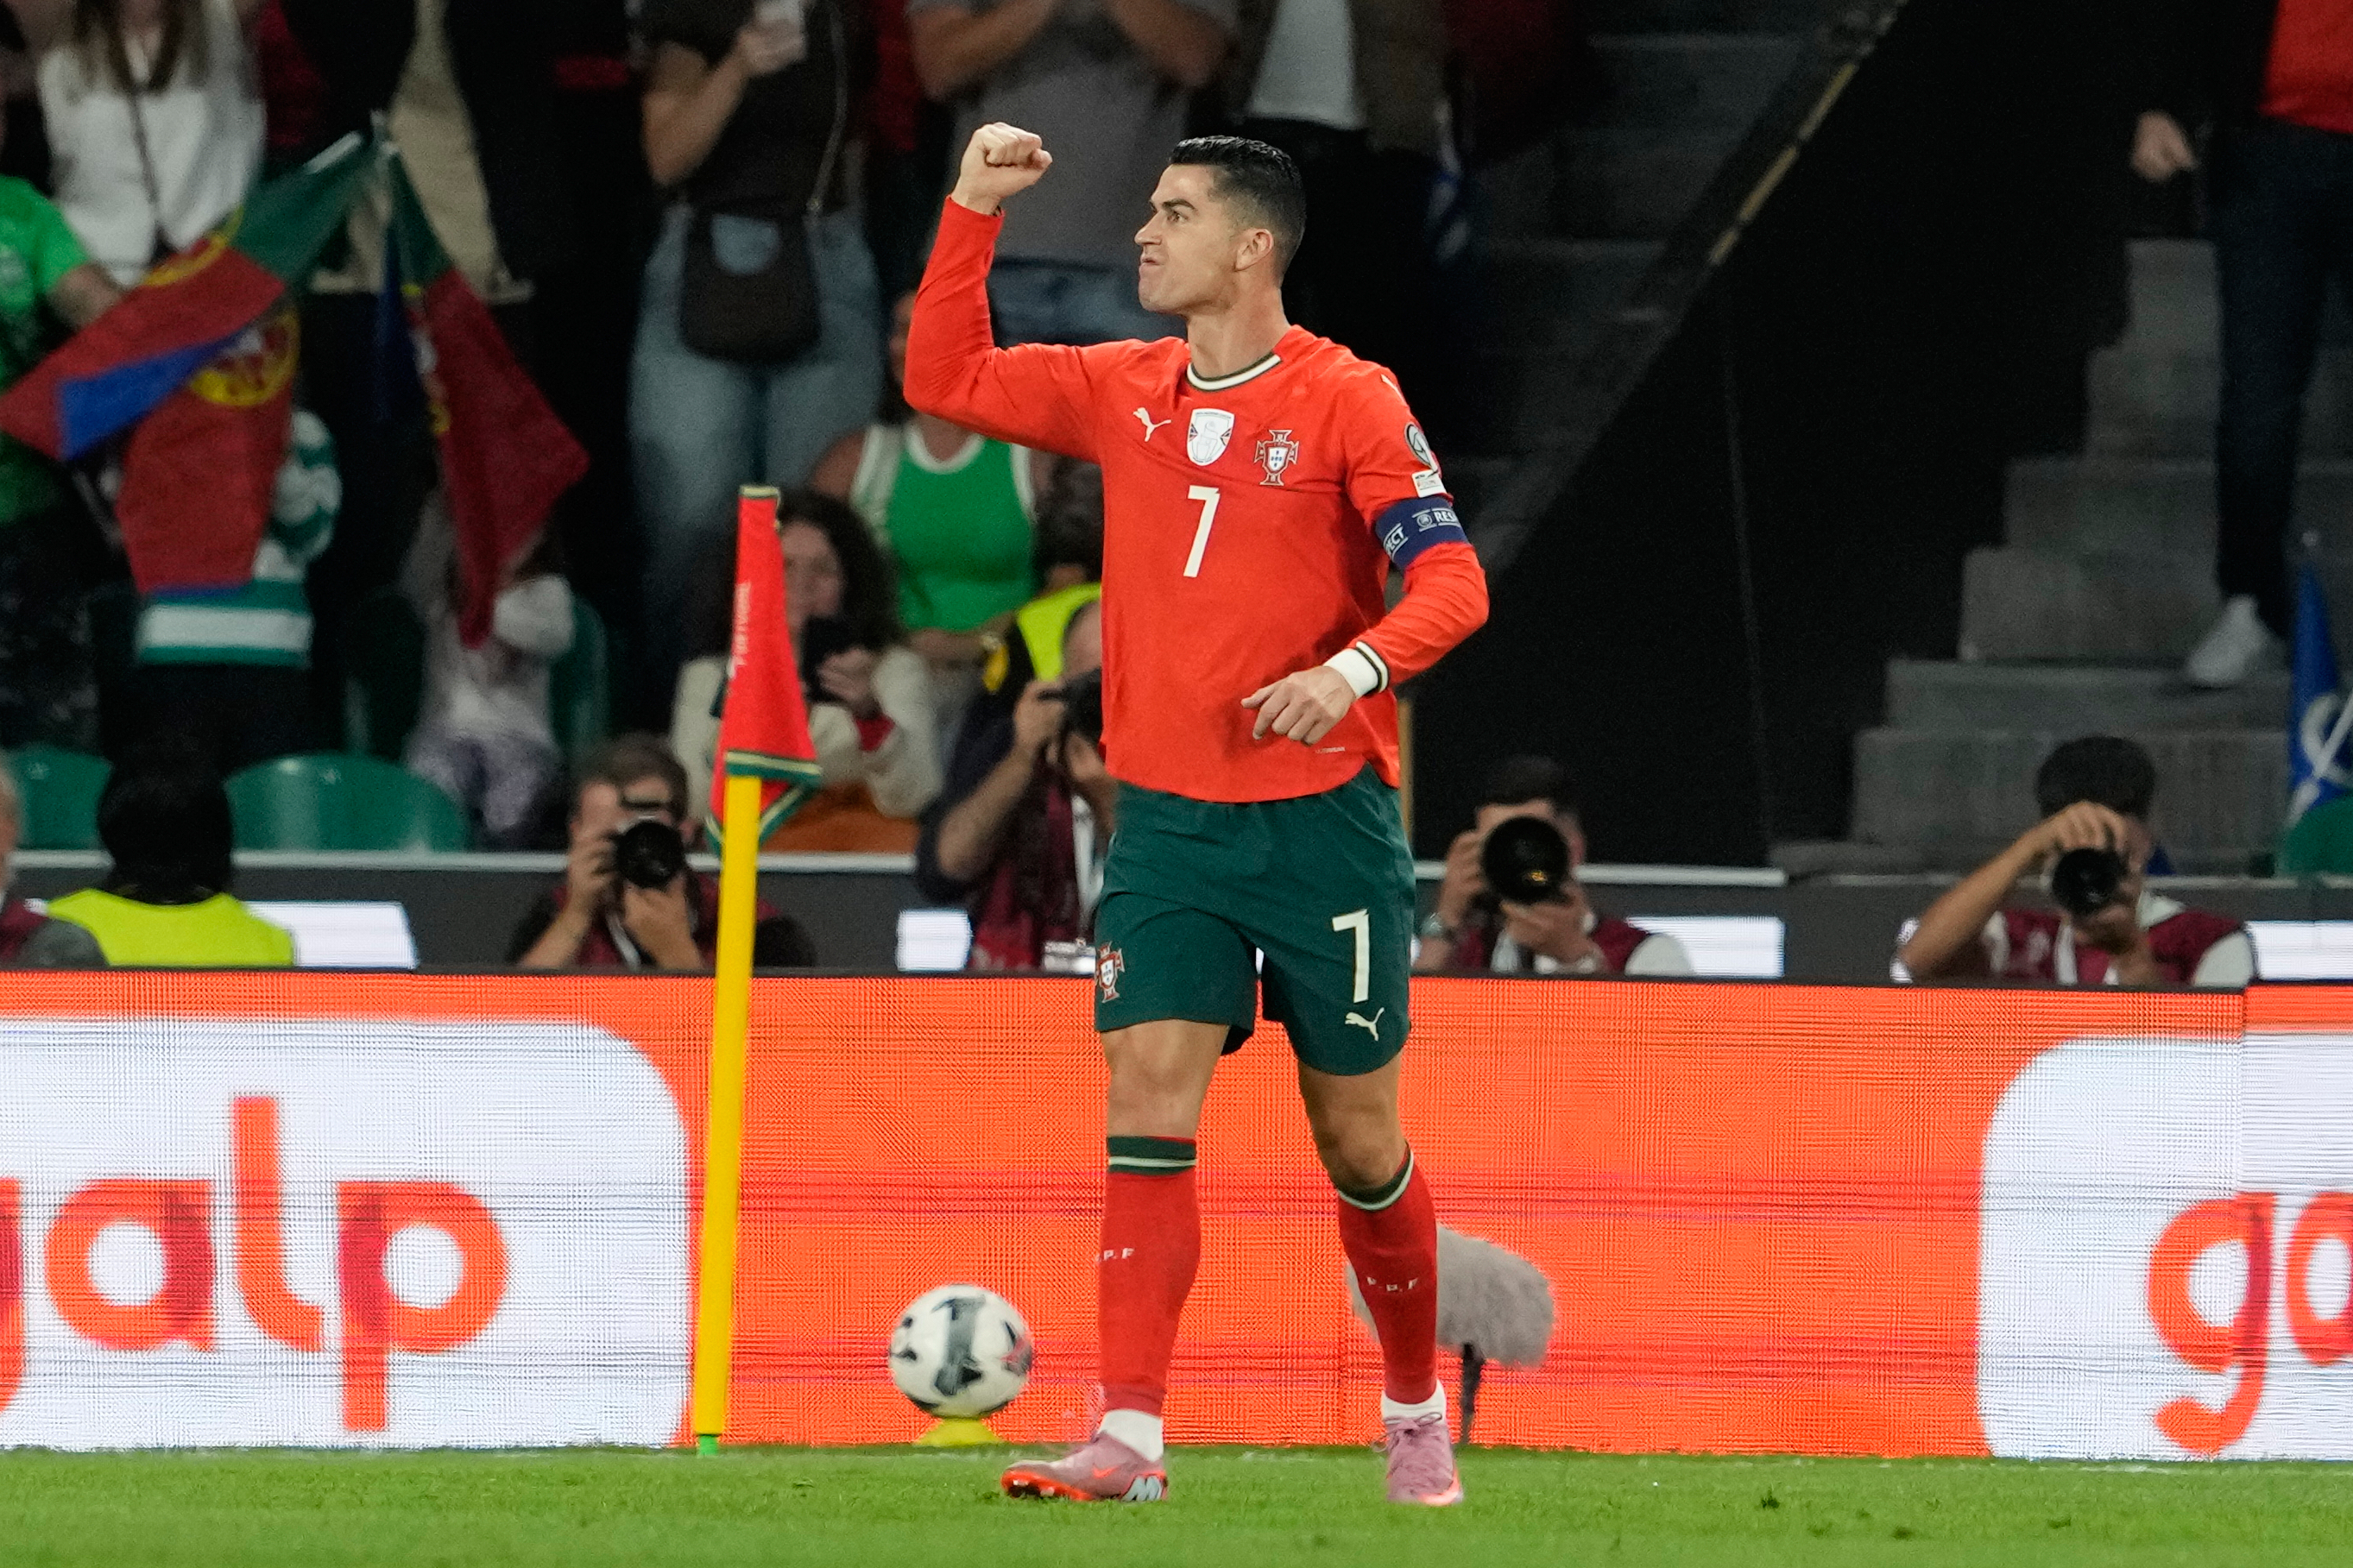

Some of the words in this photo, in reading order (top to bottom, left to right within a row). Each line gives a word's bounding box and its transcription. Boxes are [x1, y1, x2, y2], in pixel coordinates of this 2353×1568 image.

[1183, 485, 1221, 577] 7
[1332, 908, 1369, 1003] 7
[0, 1095, 508, 1432] alp
